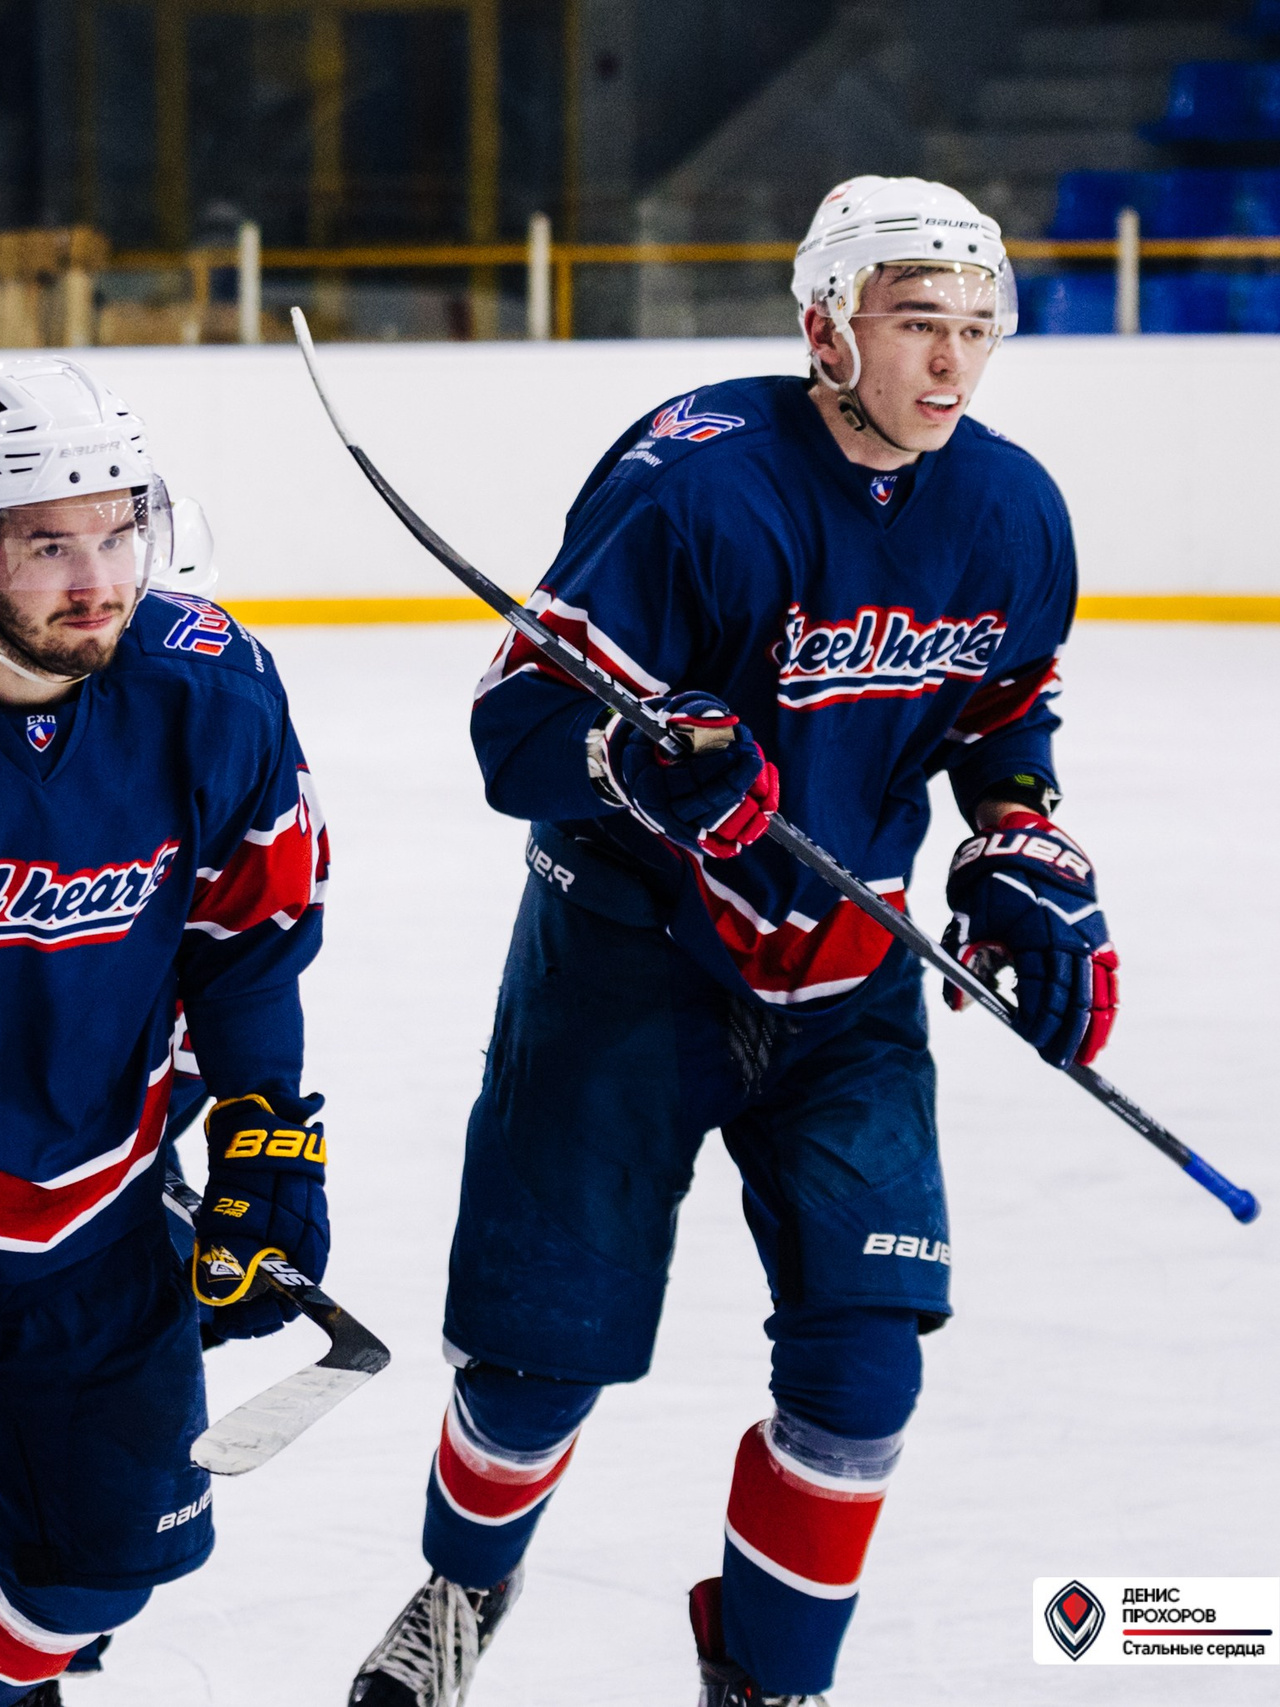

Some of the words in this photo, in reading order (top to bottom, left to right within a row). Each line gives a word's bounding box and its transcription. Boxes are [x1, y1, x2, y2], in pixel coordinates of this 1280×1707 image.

[924, 217, 980, 230] BAUER
[26, 714, 57, 726] СХП
[525, 830, 576, 893] UER
[951, 832, 1092, 881] AUER
[223, 1128, 328, 1166] BAU
[862, 1232, 951, 1267] BAUE
[156, 1487, 213, 1534] BAUE
